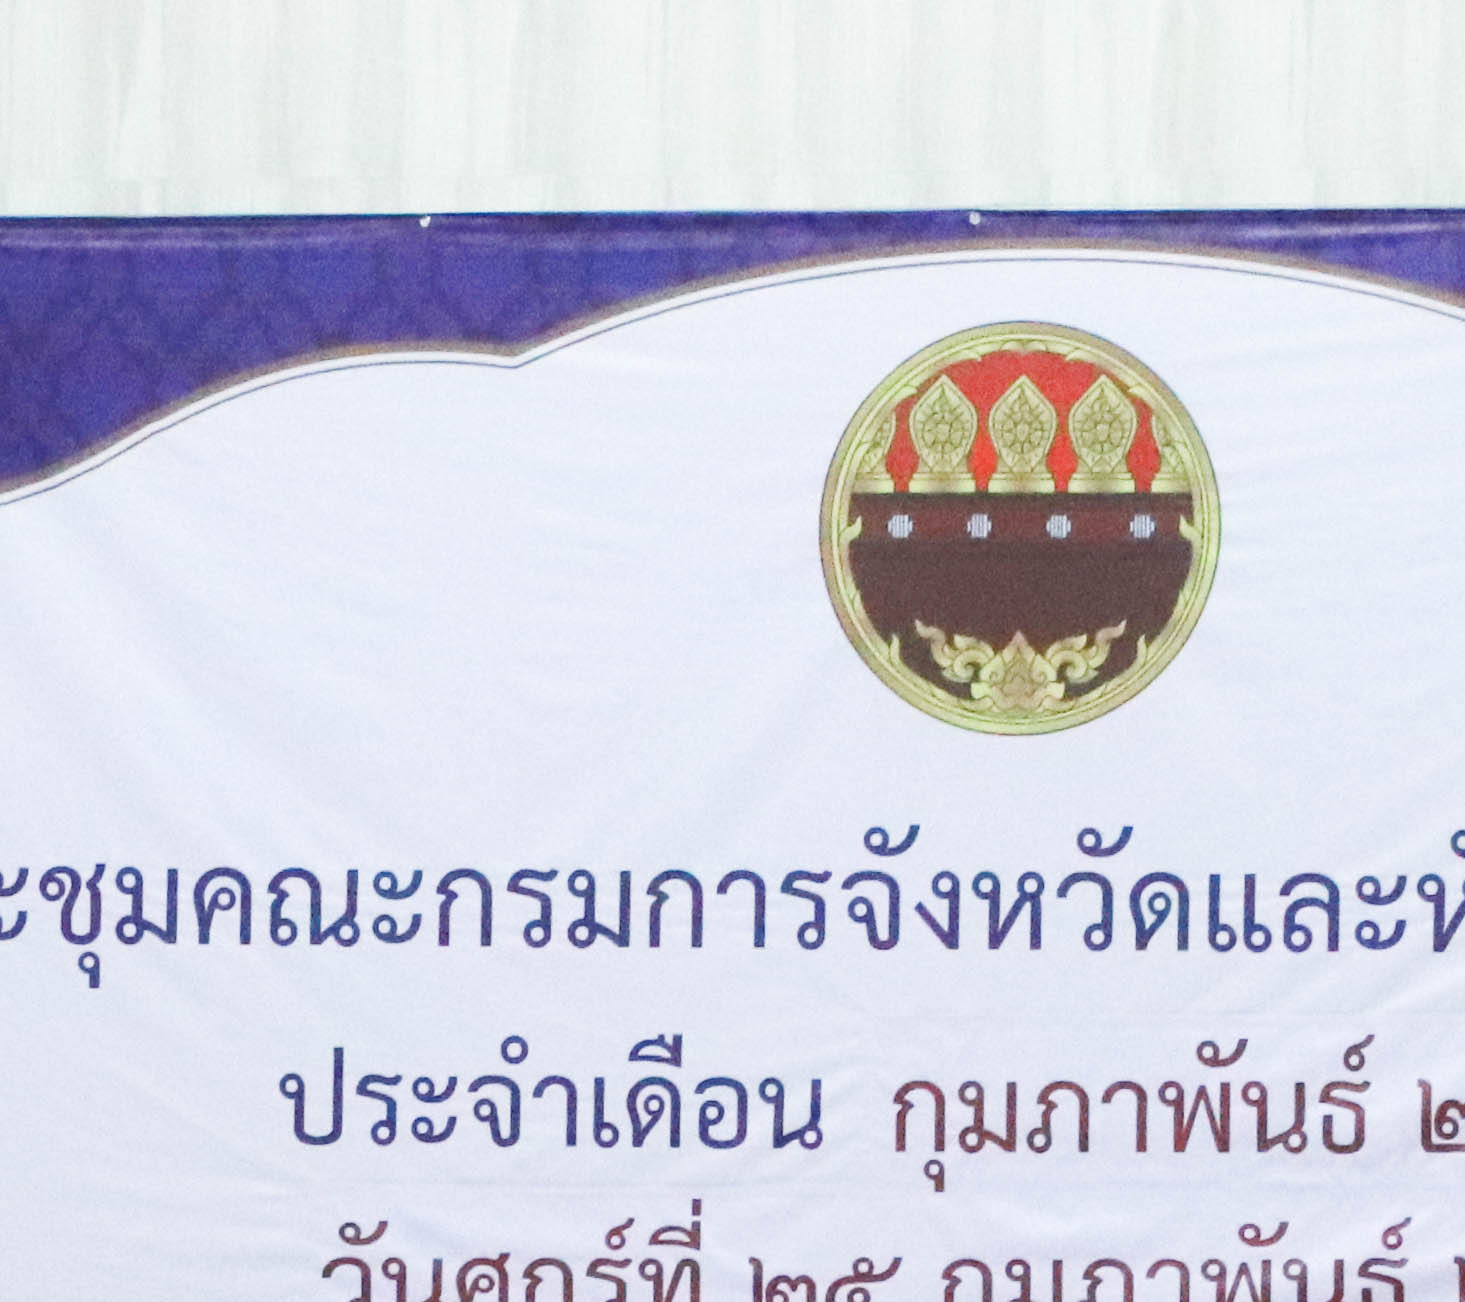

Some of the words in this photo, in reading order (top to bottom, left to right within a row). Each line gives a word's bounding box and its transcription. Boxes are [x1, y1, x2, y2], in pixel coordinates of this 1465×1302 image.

[277, 1032, 825, 1152] ประจำเดือน
[891, 1032, 1376, 1195] กุมภาพันธ์
